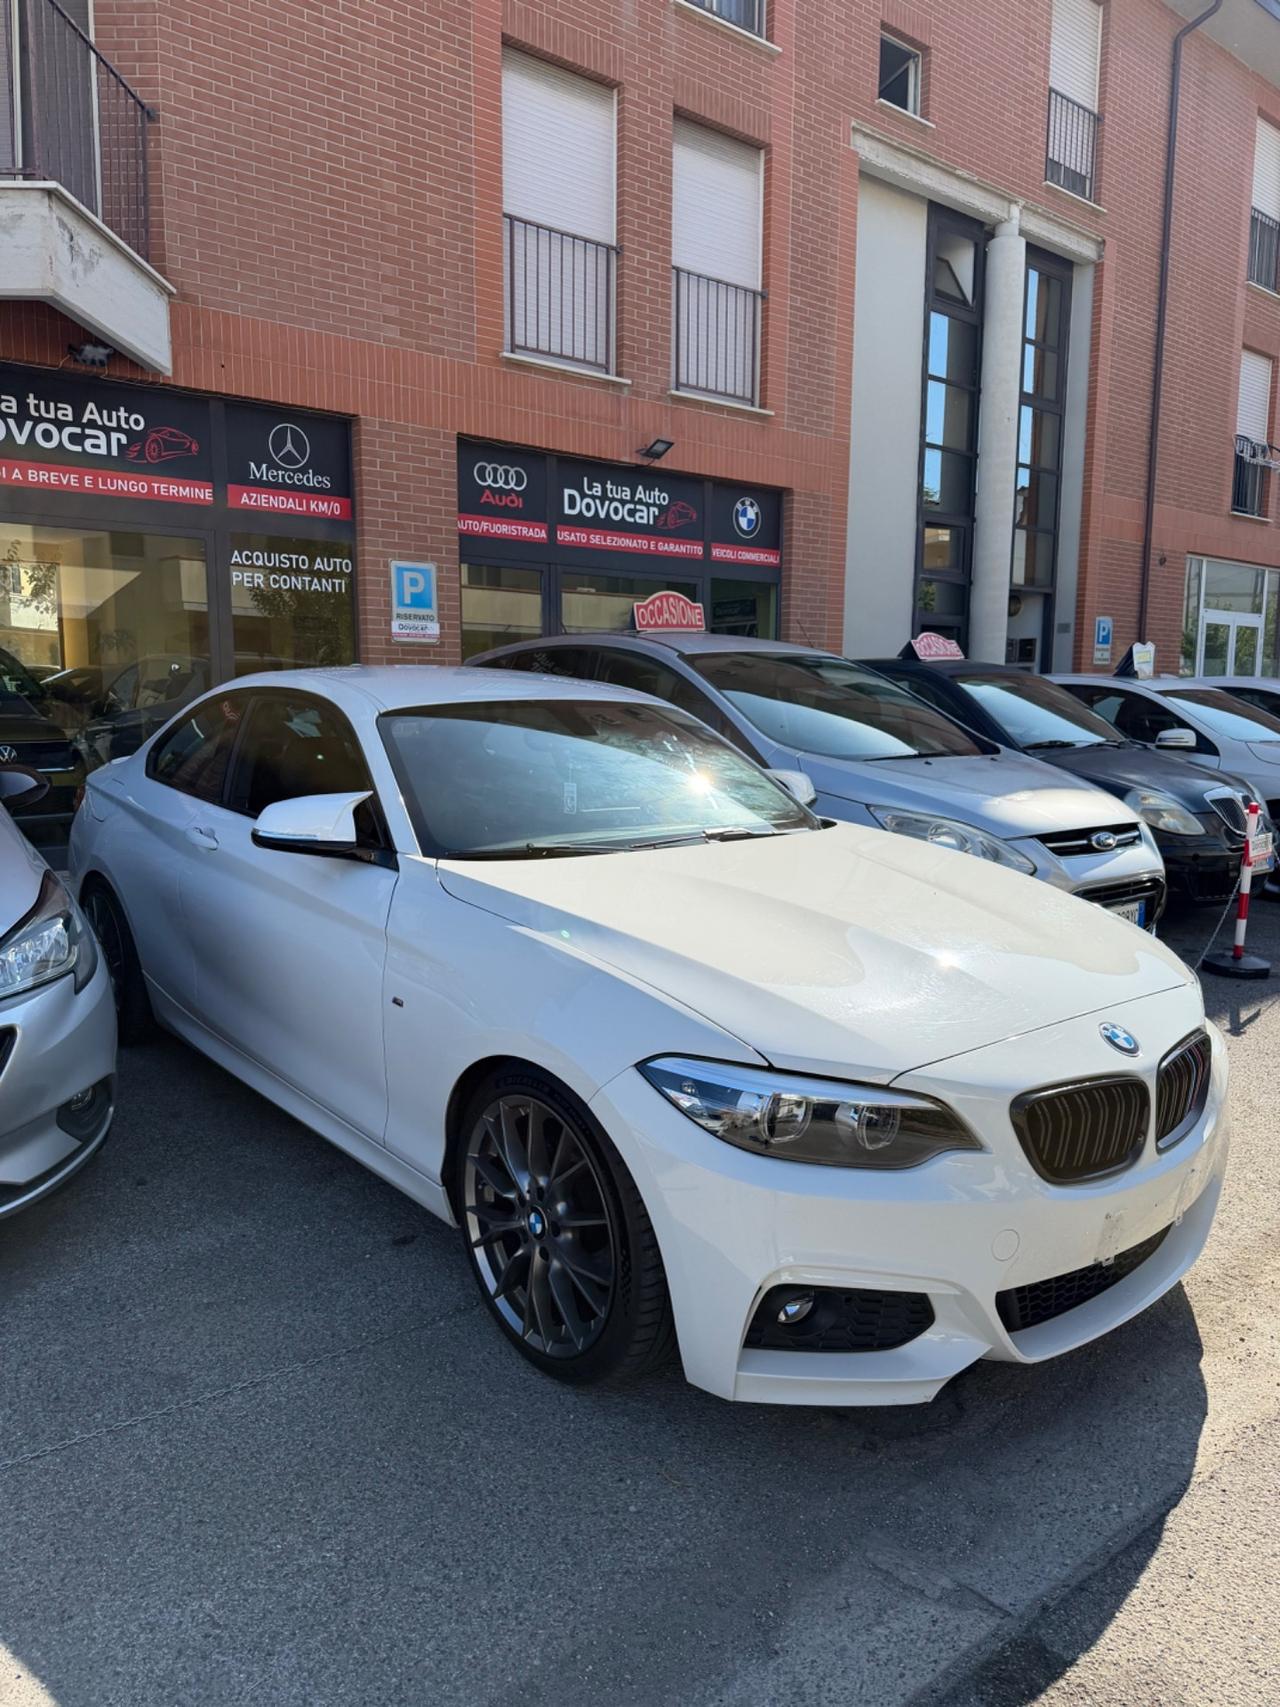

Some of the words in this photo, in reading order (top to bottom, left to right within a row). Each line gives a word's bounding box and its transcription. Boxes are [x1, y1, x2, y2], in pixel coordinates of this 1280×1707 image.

[26, 393, 73, 421] tua
[82, 402, 145, 431] Auto
[0, 418, 127, 456] vocar
[12, 468, 23, 480] A
[28, 470, 79, 487] BREVE
[84, 476, 94, 488] E
[98, 478, 148, 494] LUNGO
[151, 483, 213, 500] TERMINE
[249, 462, 331, 488] Mercedes
[240, 493, 306, 511] AZIENDALI
[480, 489, 524, 508] Audi
[583, 477, 602, 497] La
[606, 480, 631, 500] tua
[635, 485, 669, 506] Auto
[563, 488, 659, 526] Dovocar
[557, 530, 587, 544] USATO
[589, 535, 648, 550] SELEZIONATO
[650, 541, 656, 550] E
[657, 542, 704, 556] GARANTITO
[712, 547, 737, 559] VEICOLI
[738, 552, 780, 564] COMMERCIALI
[231, 550, 309, 570] ACQUISTO
[314, 557, 352, 573] AUTO
[232, 572, 265, 589] PER
[270, 575, 346, 593] CONTANTI
[403, 571, 425, 604] P
[396, 613, 435, 622] RISERVATO
[638, 599, 702, 625] OCCASIONE
[1099, 624, 1109, 642] P
